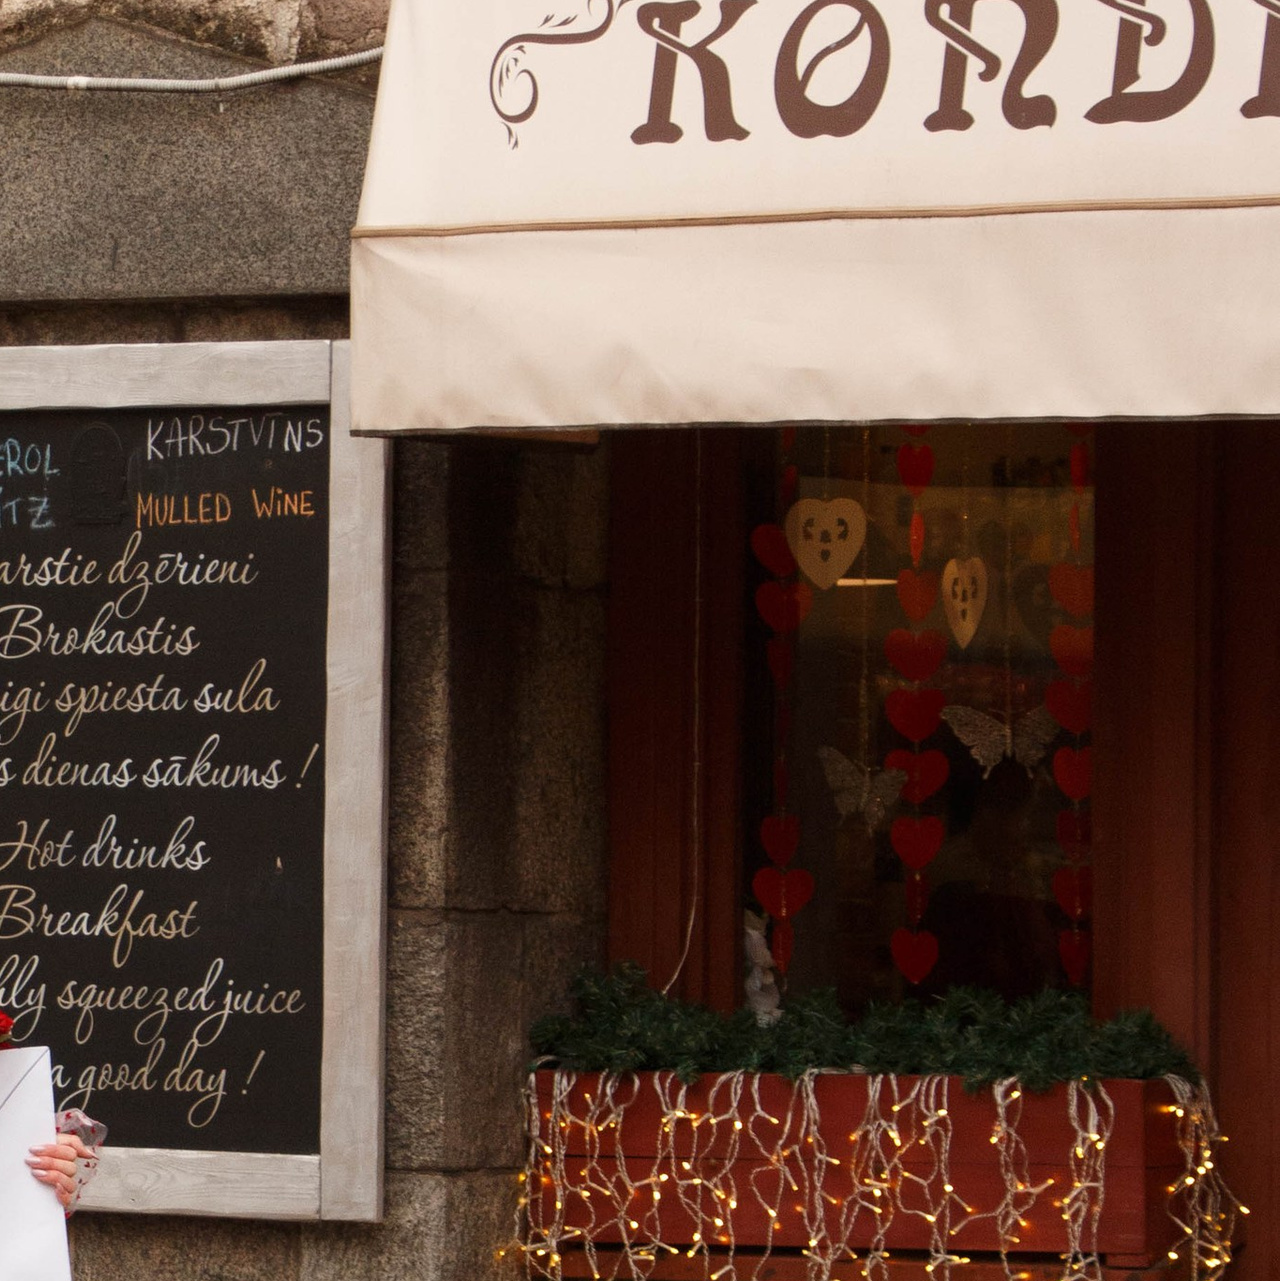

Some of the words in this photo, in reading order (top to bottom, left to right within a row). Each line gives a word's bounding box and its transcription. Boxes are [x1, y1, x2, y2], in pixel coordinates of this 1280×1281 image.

[136, 492, 231, 528] MULLED
[55, 673, 188, 736] spiesta
[194, 659, 280, 712] sula
[22, 734, 136, 787] dienas
[82, 814, 211, 871] drinks
[57, 957, 223, 1044] squeezed
[191, 983, 306, 1047] juice
[58, 1039, 167, 1112] good
[164, 1039, 228, 1127] day
